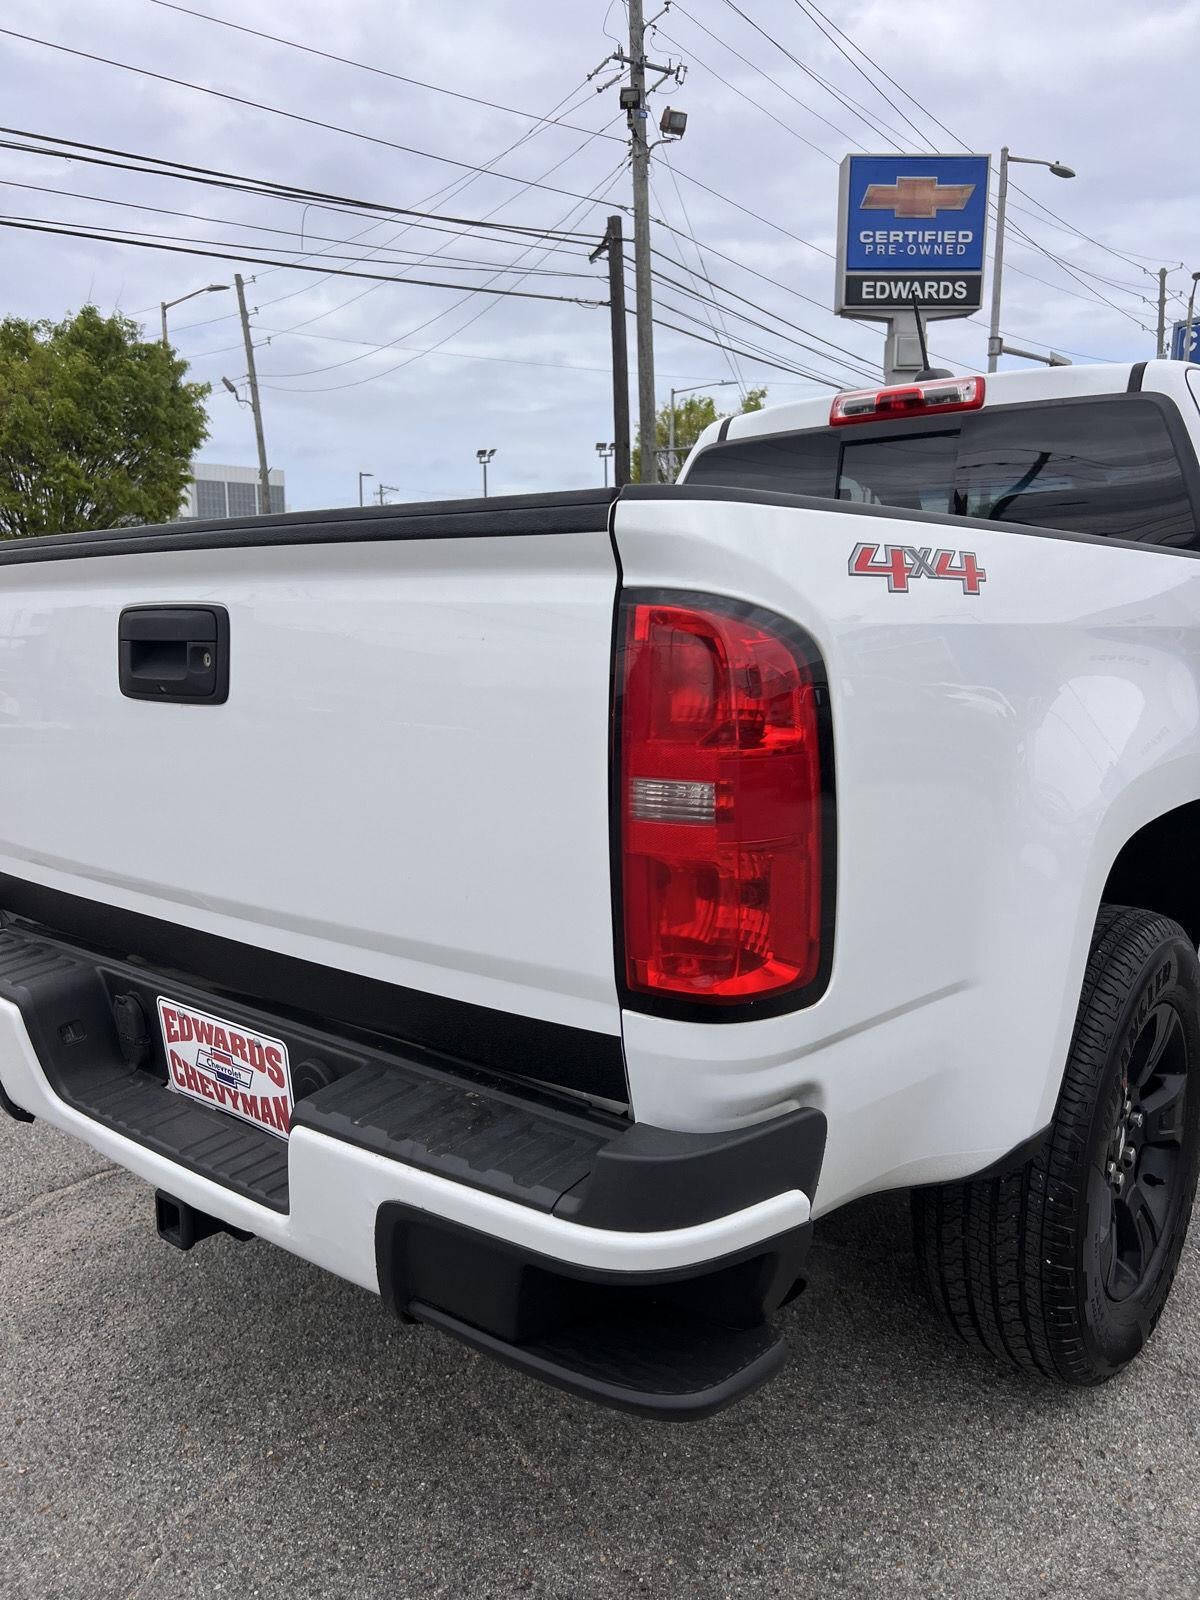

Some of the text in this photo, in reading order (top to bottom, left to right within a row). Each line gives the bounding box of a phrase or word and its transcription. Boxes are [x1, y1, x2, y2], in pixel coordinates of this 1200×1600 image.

[859, 230, 973, 243] CERTIFIED
[865, 244, 966, 255] PRE-OWNED
[861, 281, 967, 299] EDWARDS
[161, 1006, 285, 1089] EDWARDS
[206, 1057, 242, 1080] Chevrolet
[169, 1048, 291, 1135] CHEVYMAN
